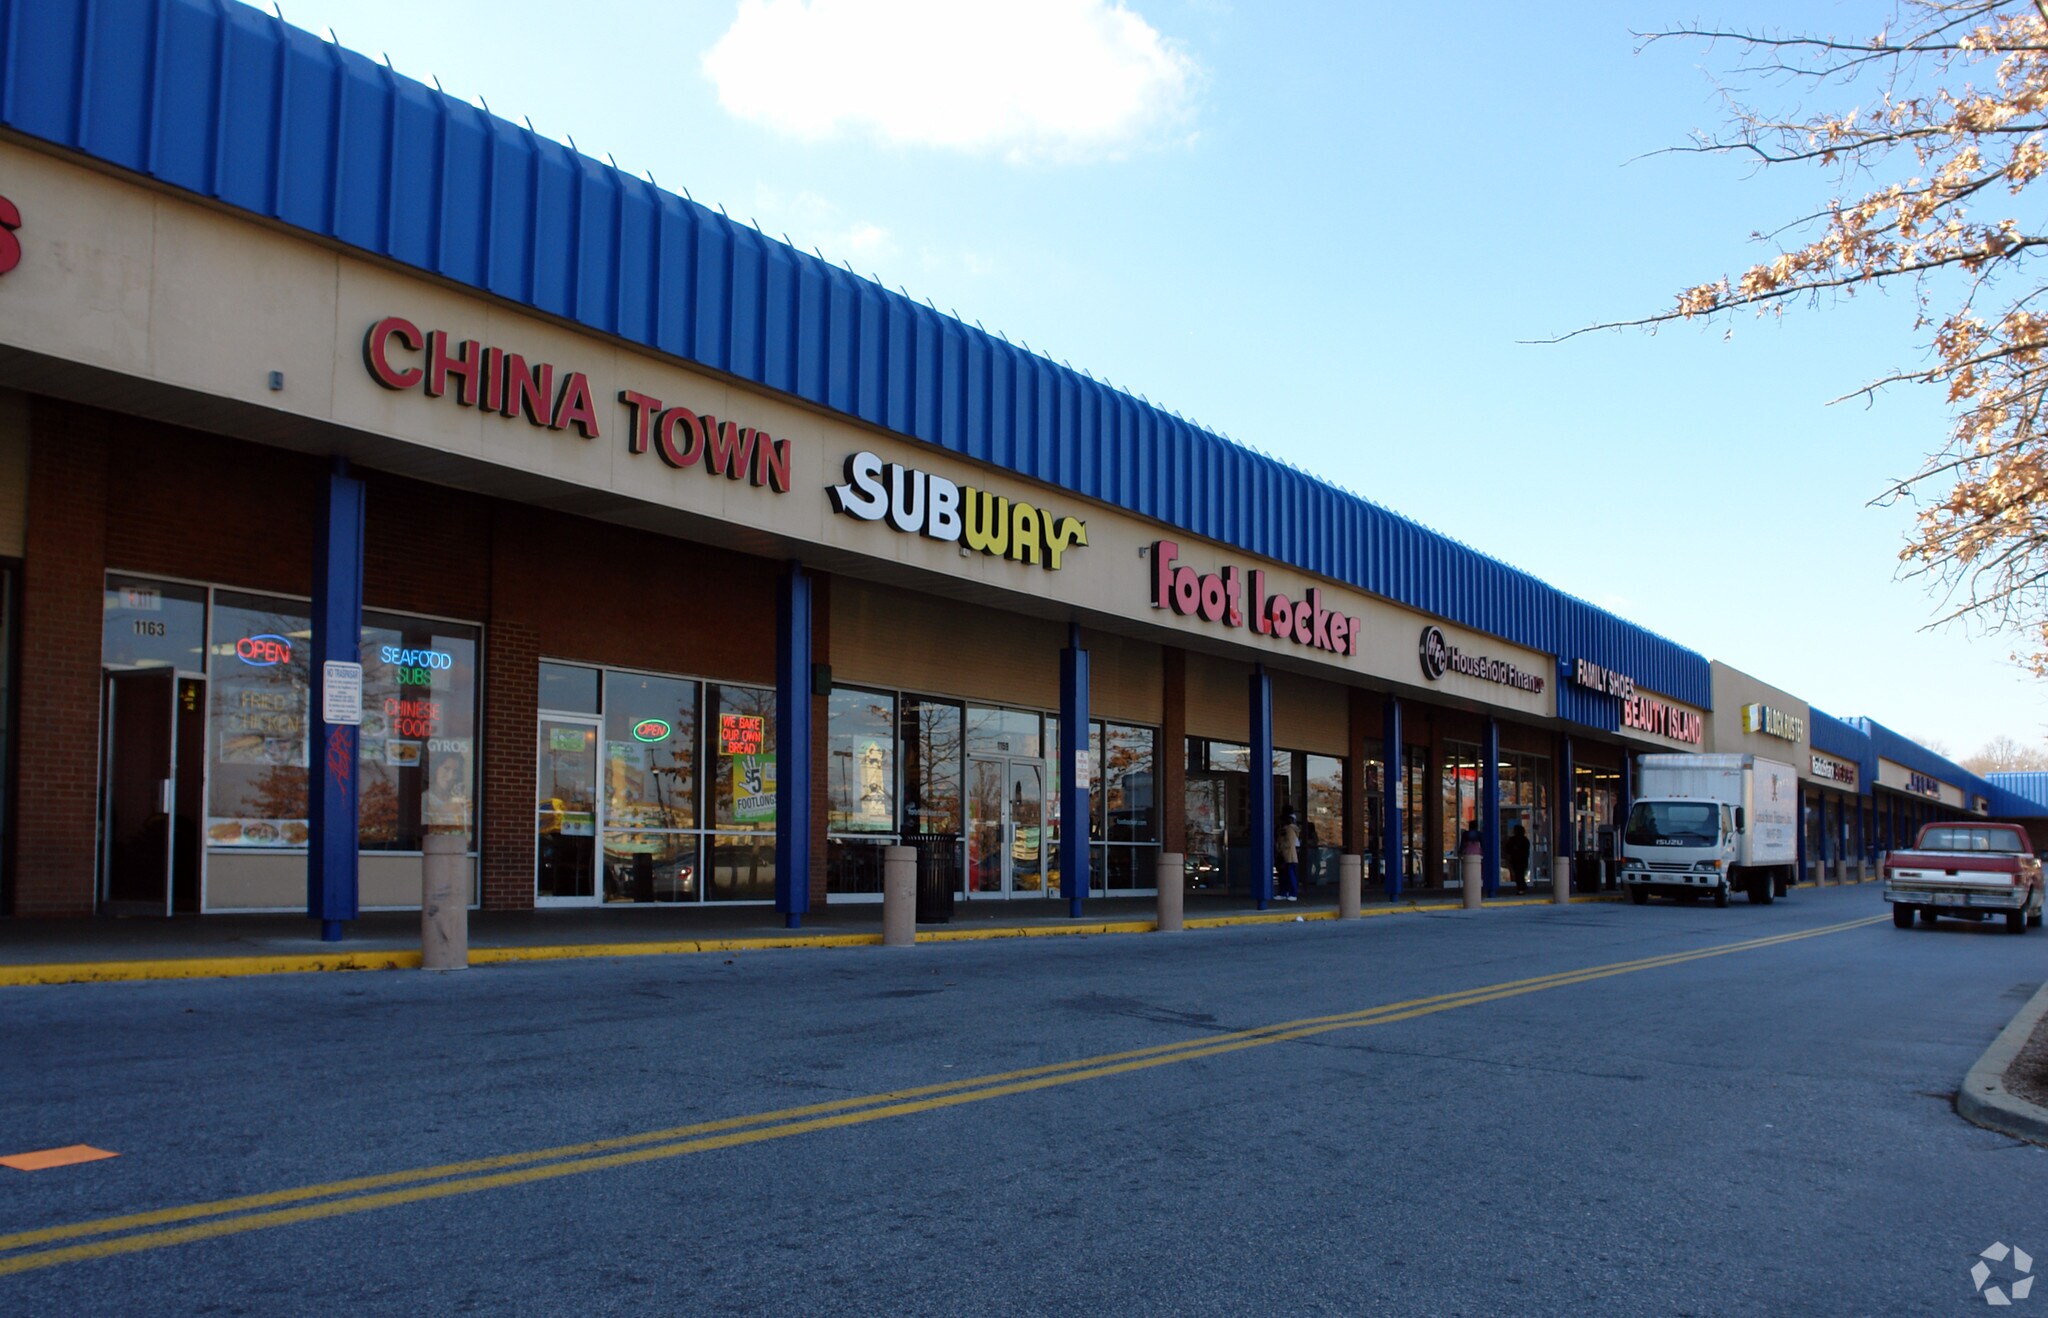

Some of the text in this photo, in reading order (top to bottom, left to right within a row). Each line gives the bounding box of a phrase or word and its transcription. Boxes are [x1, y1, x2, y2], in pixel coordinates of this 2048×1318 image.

[363, 317, 792, 494] CHINA TOWN
[826, 452, 1088, 570] SUBWAY
[128, 588, 154, 609] EXIT
[1151, 540, 1361, 657] Foot Locker
[134, 620, 165, 637] 1163
[237, 637, 291, 663] OPEN
[381, 645, 452, 670] SEAFOOD
[396, 666, 433, 687] SUBS
[1577, 658, 1635, 700] FAMILY SHOES
[241, 690, 286, 711] FRIED
[384, 697, 441, 721] CHINESE
[393, 717, 433, 737] FOOD
[637, 723, 667, 736] OPEN
[722, 715, 760, 730] WE BAKE
[1624, 695, 1702, 744] BEAUTY ISLAND
[721, 728, 762, 742] OUR OWN
[427, 740, 469, 753] GYROS
[728, 741, 757, 754] BREAD
